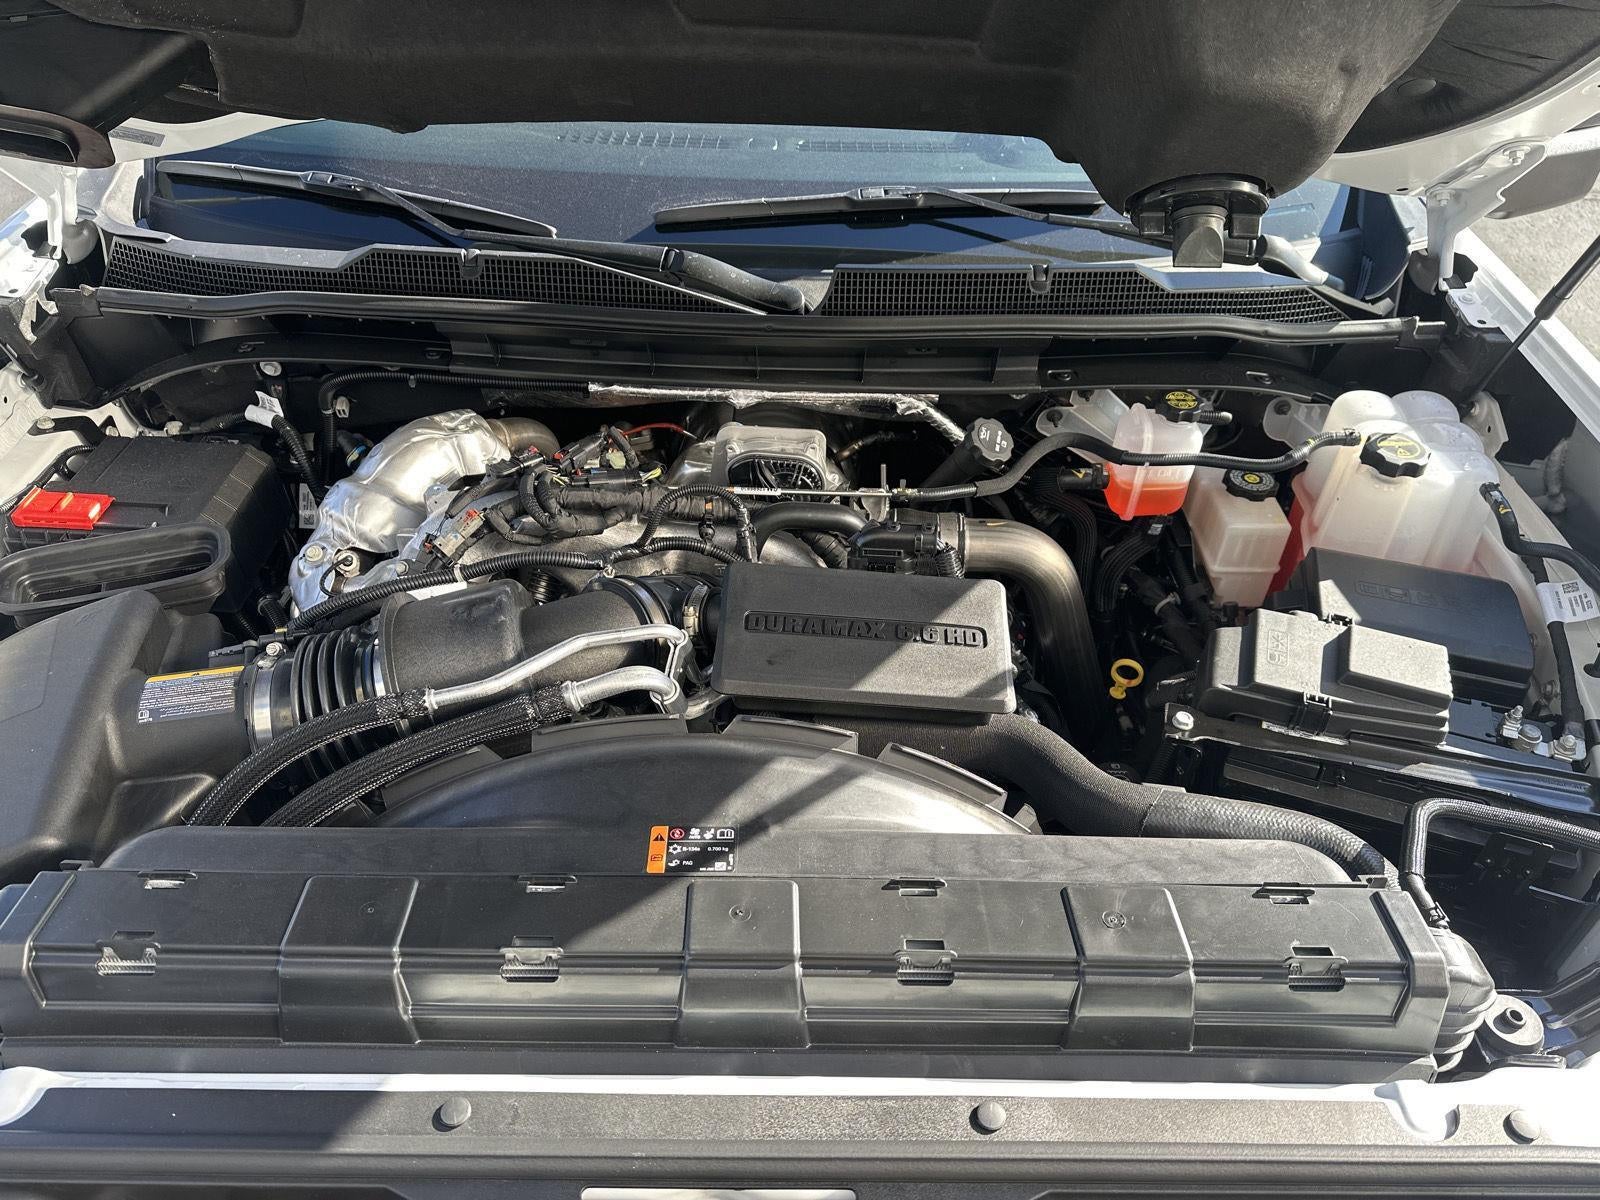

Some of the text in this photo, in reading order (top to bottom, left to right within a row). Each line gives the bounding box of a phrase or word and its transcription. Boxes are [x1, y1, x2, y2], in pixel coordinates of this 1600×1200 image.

[748, 614, 982, 647] DURAMAX 6.6 HD
